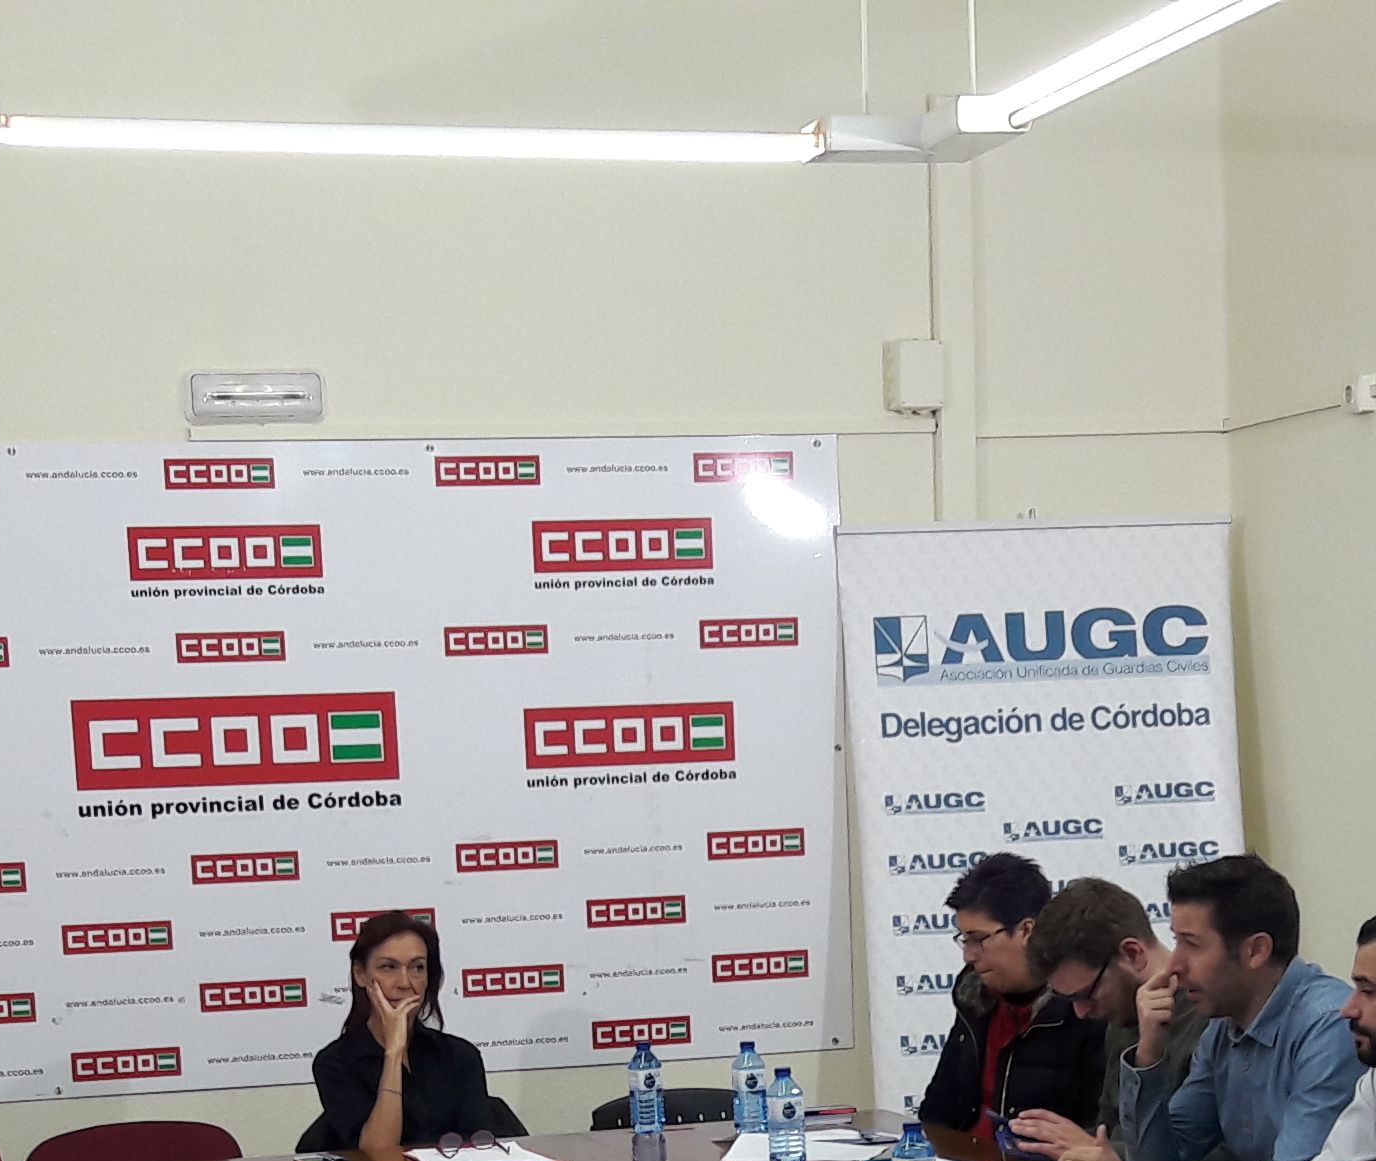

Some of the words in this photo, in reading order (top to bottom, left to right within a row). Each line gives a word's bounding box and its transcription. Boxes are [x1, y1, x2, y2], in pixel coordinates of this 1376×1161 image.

[169, 465, 247, 483] CCOO
[440, 462, 515, 480] CCOO
[138, 537, 275, 569] CCOO
[541, 530, 669, 561] CCOO
[131, 587, 168, 597] unión
[174, 586, 241, 598] provincial
[247, 586, 262, 595] de
[268, 585, 324, 594] Córdoba
[535, 580, 569, 588] unión
[575, 578, 637, 590] provincial
[642, 578, 656, 586] de
[662, 576, 714, 585] Córdoba
[449, 631, 523, 650] CCOO
[704, 624, 774, 642] CCOO
[941, 605, 1209, 664] AUGC
[181, 638, 259, 657] CCOO
[940, 667, 1013, 682] Asociación
[1016, 664, 1078, 678] Unificada
[1082, 664, 1099, 675] de
[1102, 661, 1163, 674] Guardias
[1166, 660, 1209, 672] Civiles
[881, 707, 1042, 743] Delegación
[1051, 707, 1085, 731] de
[1091, 702, 1211, 730] Córdoba
[89, 714, 320, 769] CCOO
[535, 717, 684, 755] CCOO
[527, 776, 568, 787] unión
[574, 772, 646, 788] provincial
[652, 772, 669, 782] de
[675, 769, 736, 781] Córdoba
[1135, 781, 1216, 799] AUGC
[79, 800, 142, 817] unión
[151, 795, 264, 819] provincial
[273, 795, 299, 810] de
[308, 791, 401, 809] Córdoba
[905, 791, 986, 810] AUGC
[1025, 818, 1103, 837] AUGC
[712, 835, 781, 854] CCOO
[1139, 840, 1219, 859] AUGC
[461, 847, 533, 866] CCOO
[197, 859, 273, 878] CCOO
[591, 902, 661, 922] CCOO
[67, 928, 146, 948] CCOO
[717, 957, 785, 976] CCOO
[467, 972, 539, 991] CCOO
[205, 986, 281, 1005] CCOO
[597, 1024, 667, 1043] CCOO
[77, 1055, 154, 1075] CCOO
